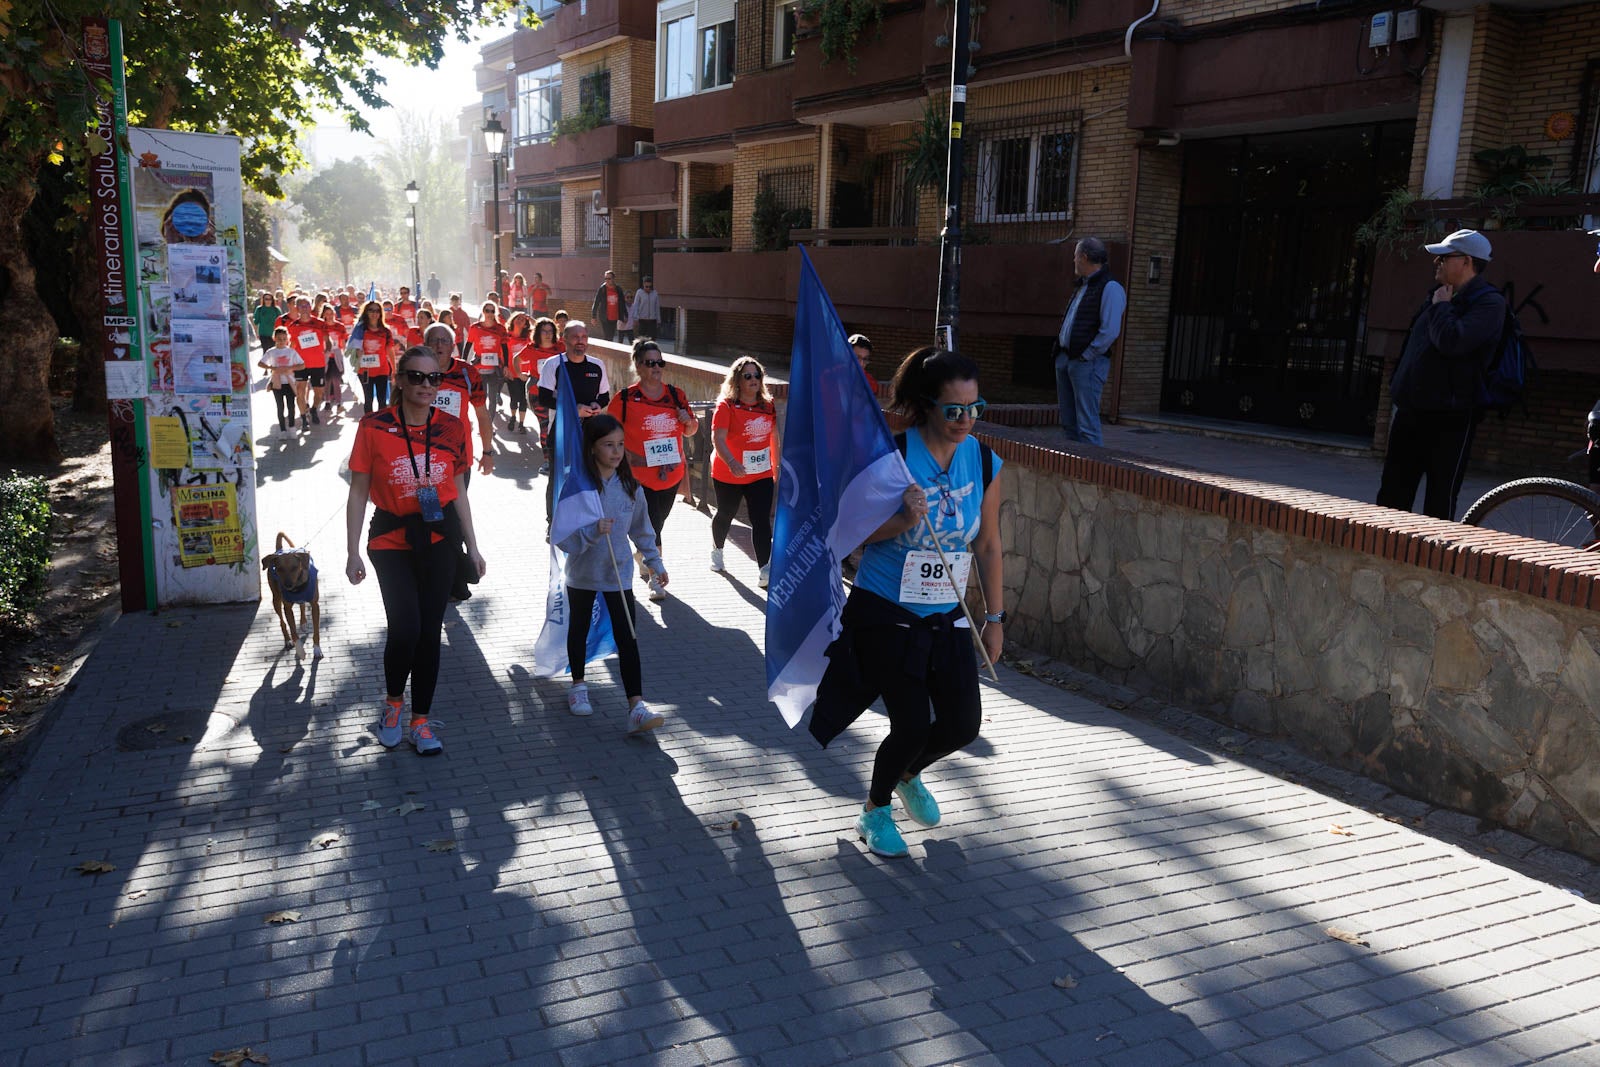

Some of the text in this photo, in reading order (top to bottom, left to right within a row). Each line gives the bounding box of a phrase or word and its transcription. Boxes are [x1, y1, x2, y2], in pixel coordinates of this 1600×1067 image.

[1297, 177, 1308, 198] 2
[106, 317, 135, 325] MPS
[650, 443, 673, 454] 1286
[750, 453, 766, 463] 968
[179, 488, 226, 501] MOLINA
[213, 535, 230, 546] 149
